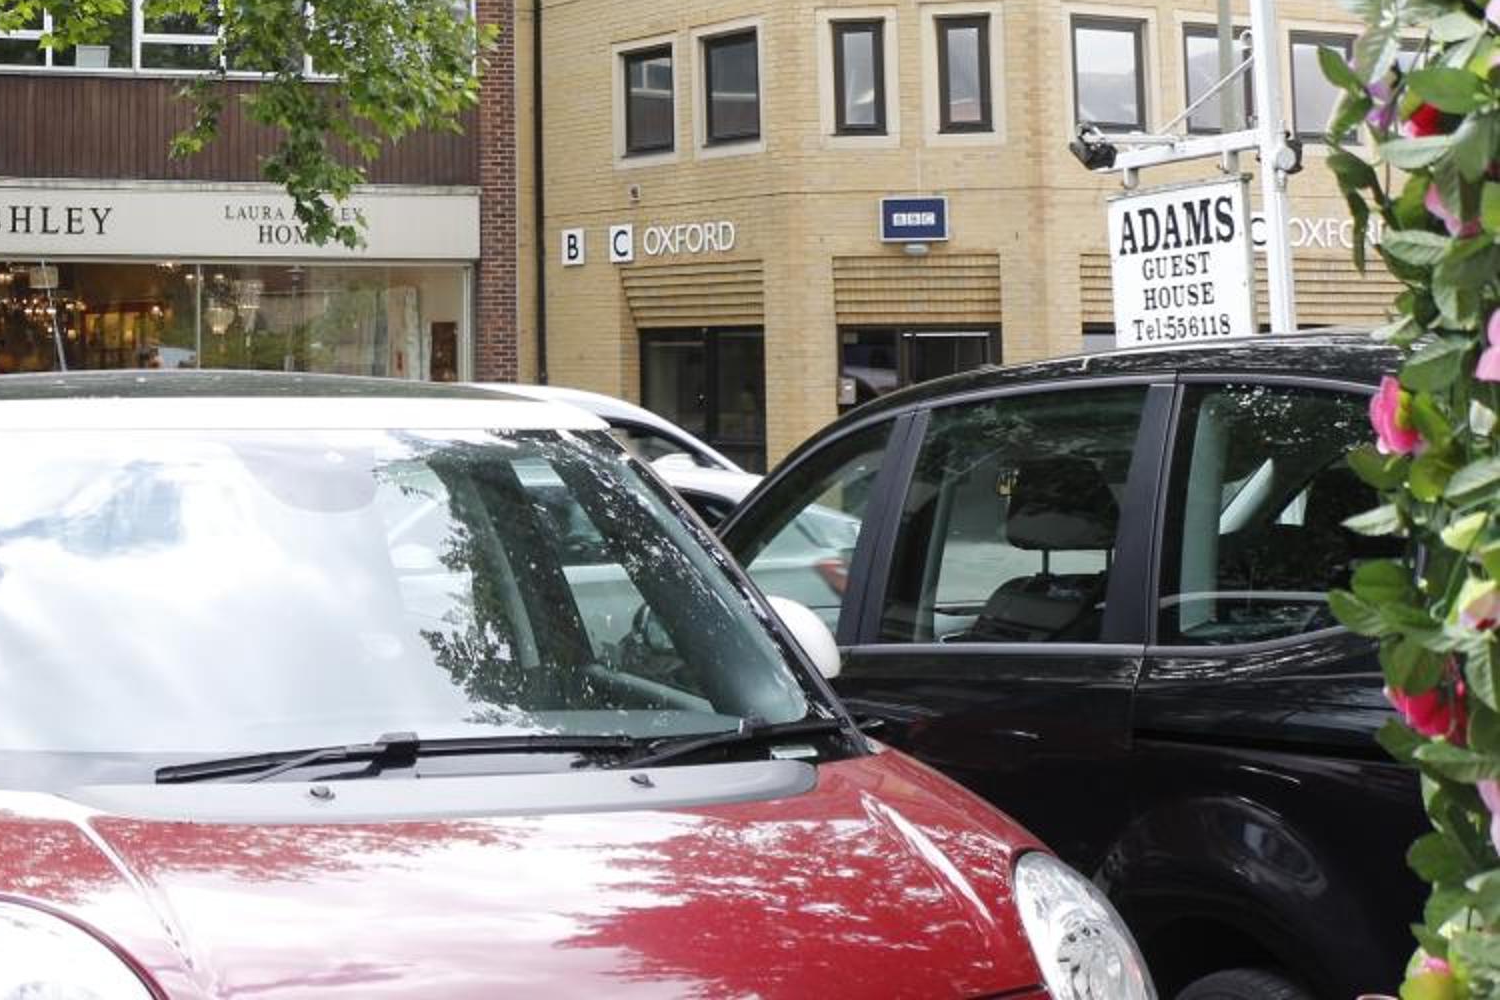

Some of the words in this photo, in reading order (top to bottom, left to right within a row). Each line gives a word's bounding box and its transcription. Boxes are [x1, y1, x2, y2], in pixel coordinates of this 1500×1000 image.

[225, 205, 285, 220] LAURA
[1119, 196, 1235, 255] ADAMS
[643, 220, 735, 256] OXFORD
[1142, 252, 1211, 279] GUEST
[1143, 282, 1214, 310] HOUSE
